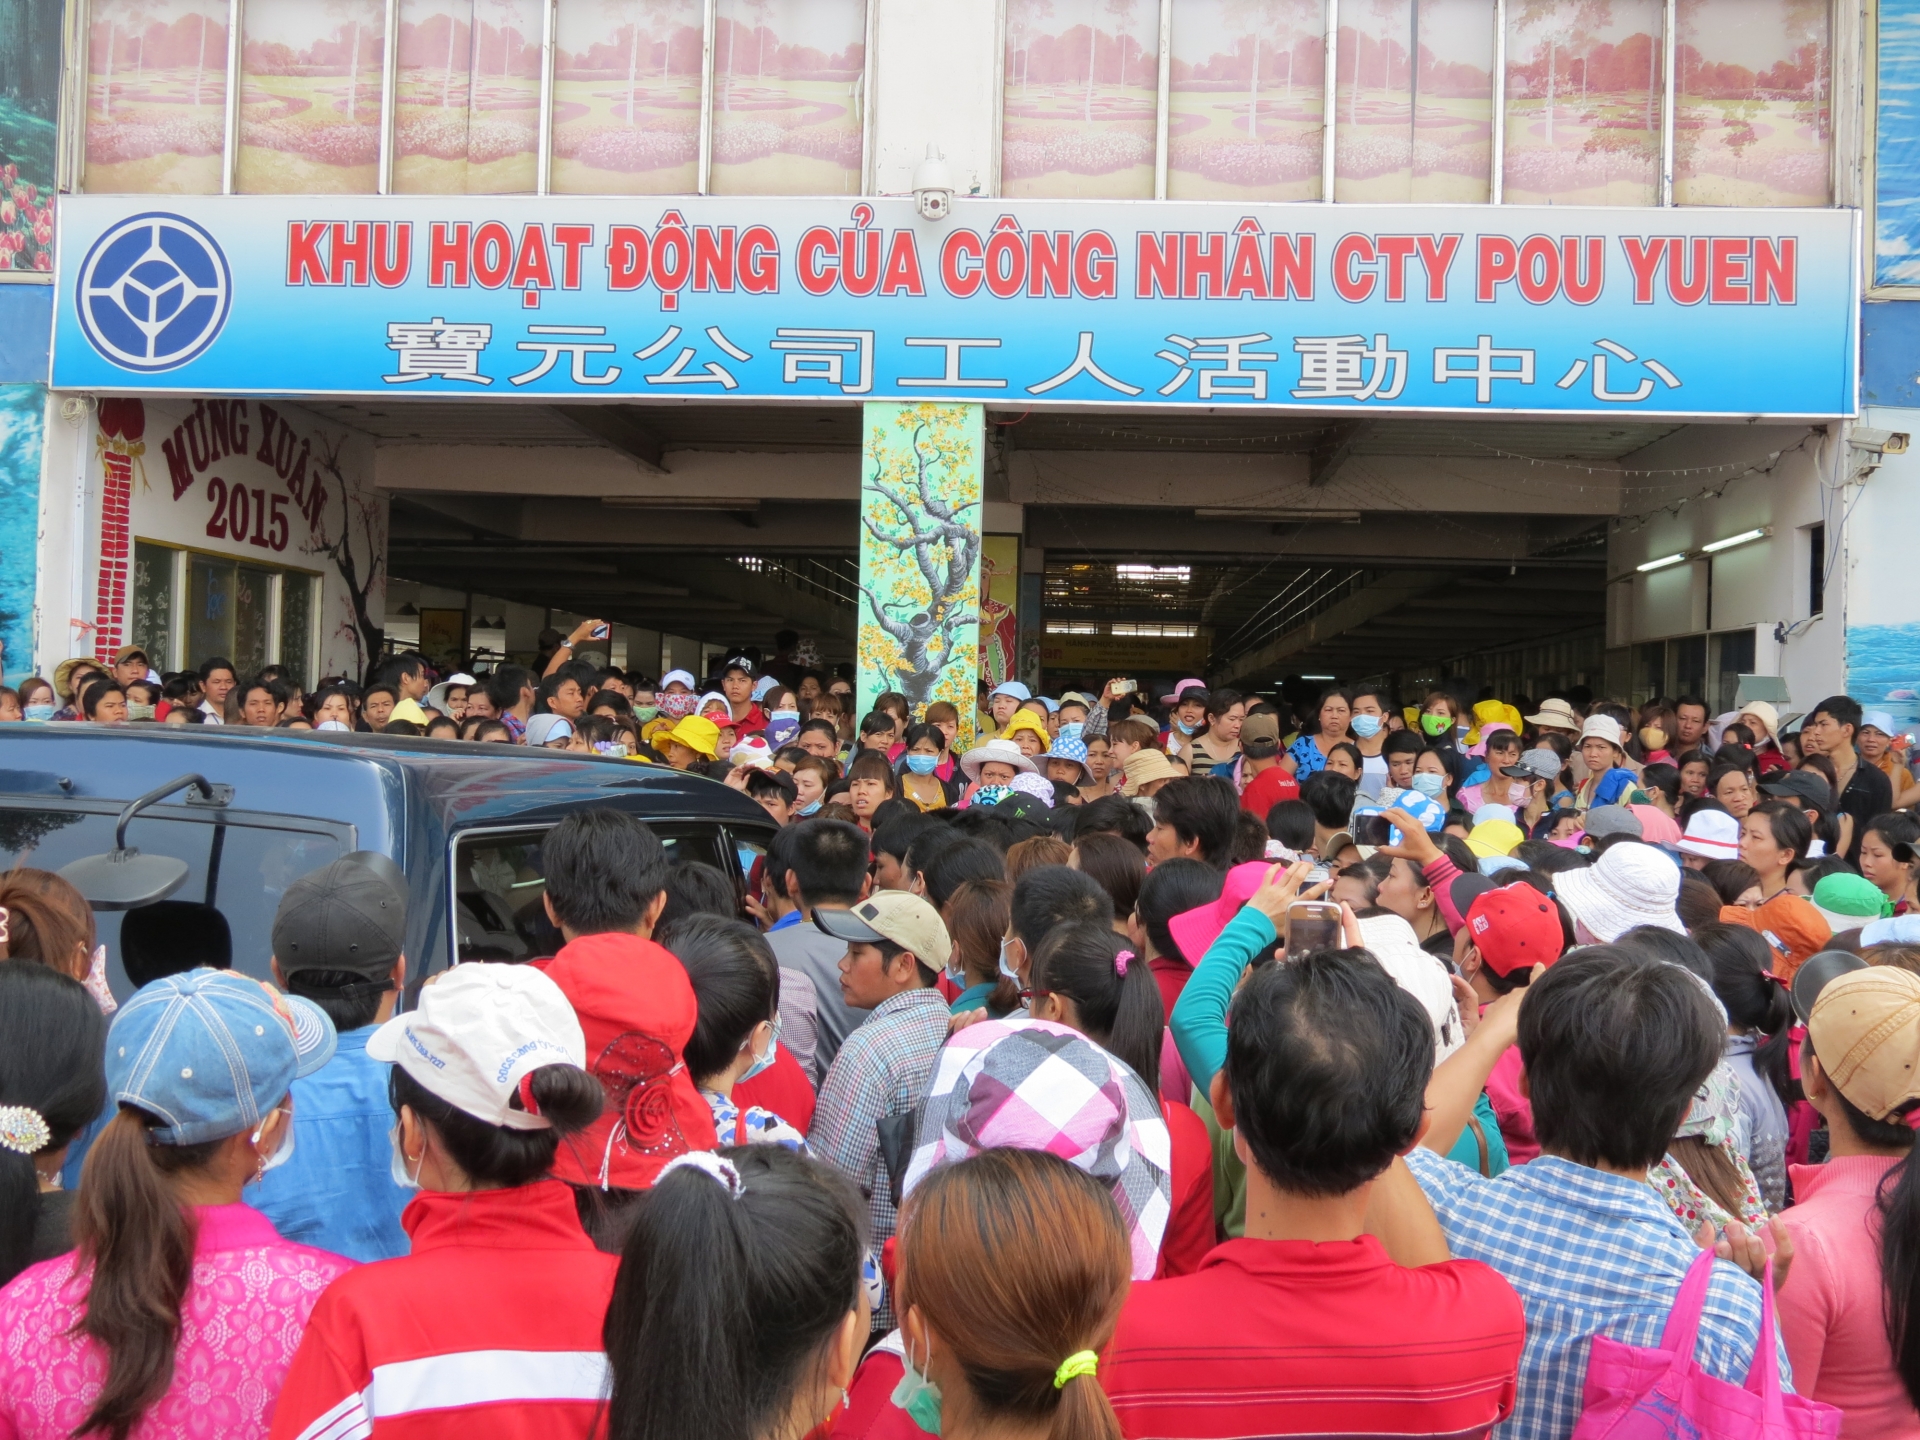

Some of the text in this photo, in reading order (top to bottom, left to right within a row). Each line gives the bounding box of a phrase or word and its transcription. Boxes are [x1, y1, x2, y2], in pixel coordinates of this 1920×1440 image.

[286, 203, 1798, 312] KHU HOẠT ĐỘNG CỦA CÔNG NHÂN CTY POU YUEN
[381, 317, 1683, 404] 寶元公司工人活動中心
[206, 476, 290, 552] 2015
[257, 402, 328, 533] XUÂN
